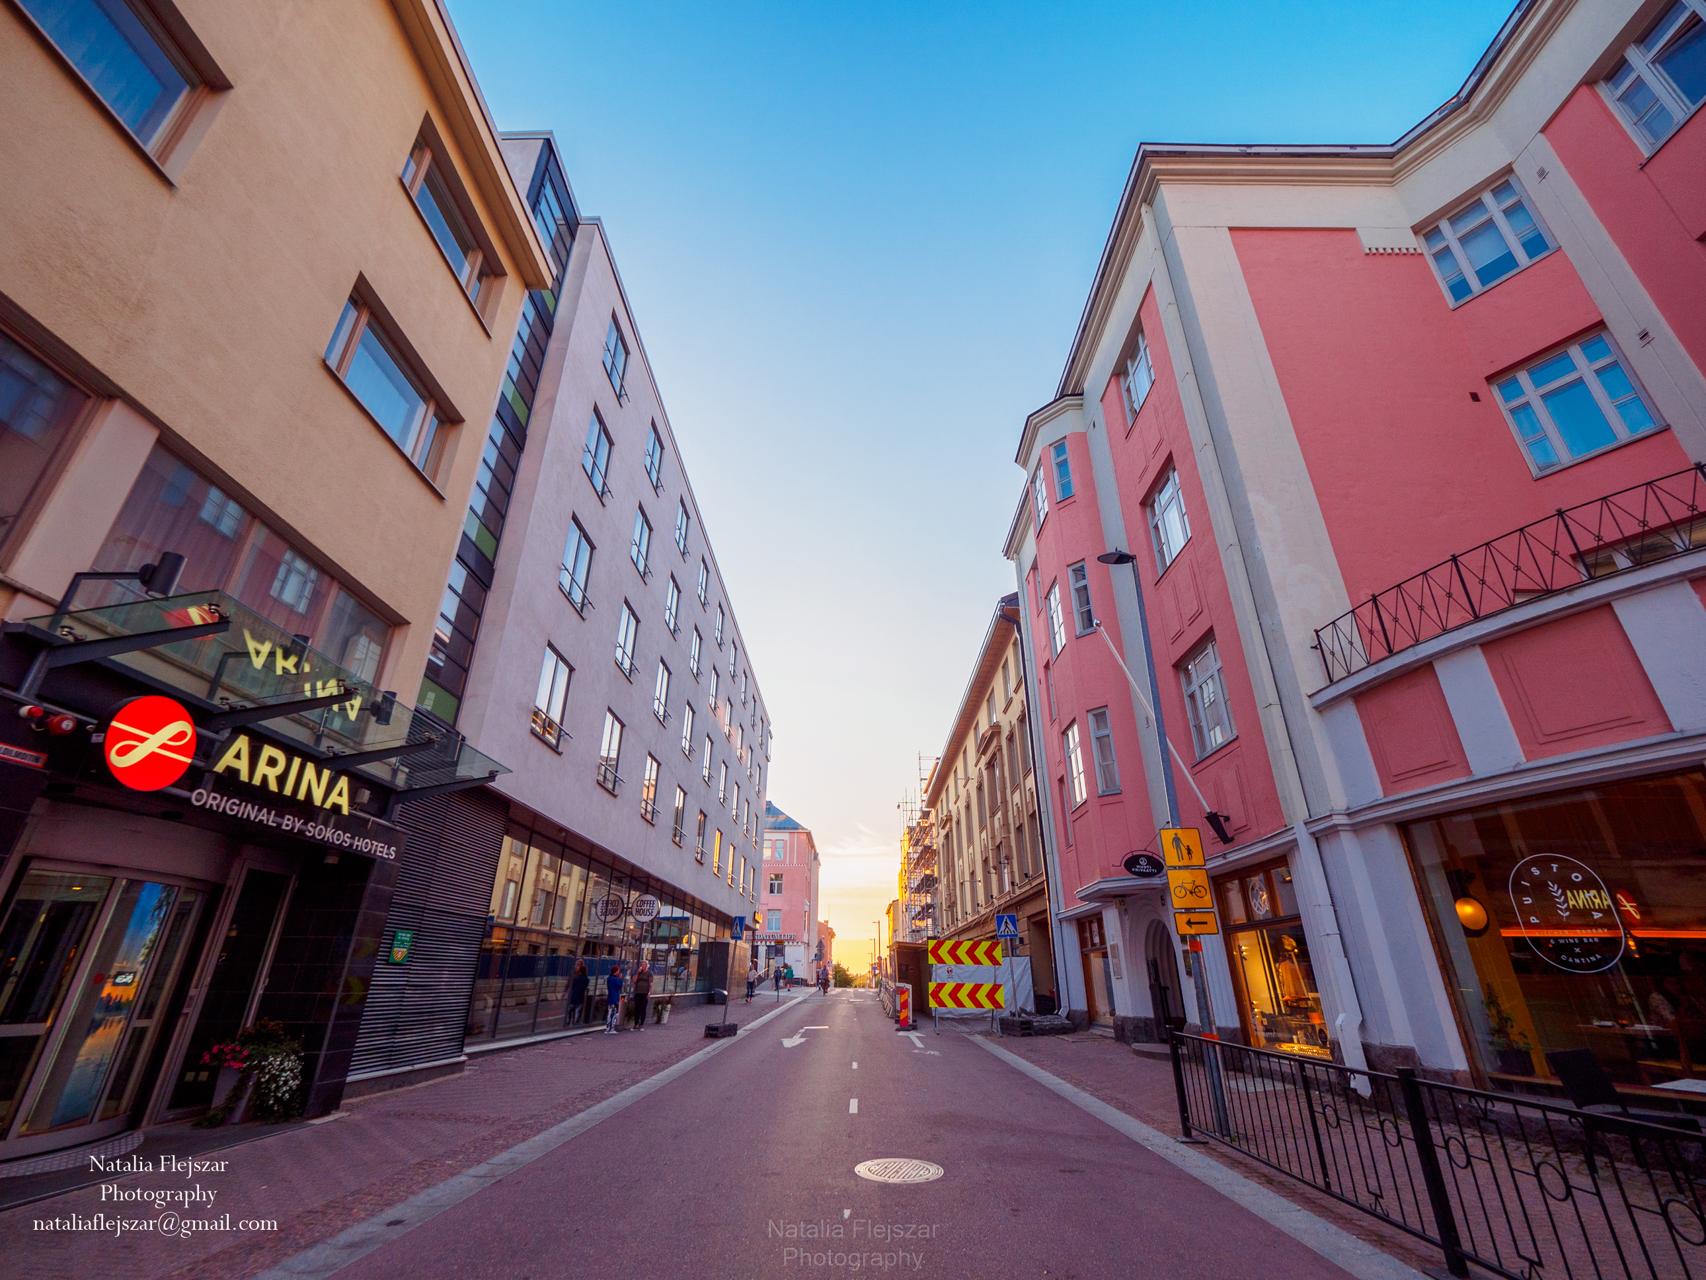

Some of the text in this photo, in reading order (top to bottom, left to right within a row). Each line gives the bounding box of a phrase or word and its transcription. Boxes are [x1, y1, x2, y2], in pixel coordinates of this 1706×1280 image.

[213, 734, 349, 816] ARINA
[191, 788, 397, 860] ORIGINAL BY SOKOS HOTELS
[634, 908, 654, 916] HOUSE
[1560, 954, 1603, 963] CANTINA
